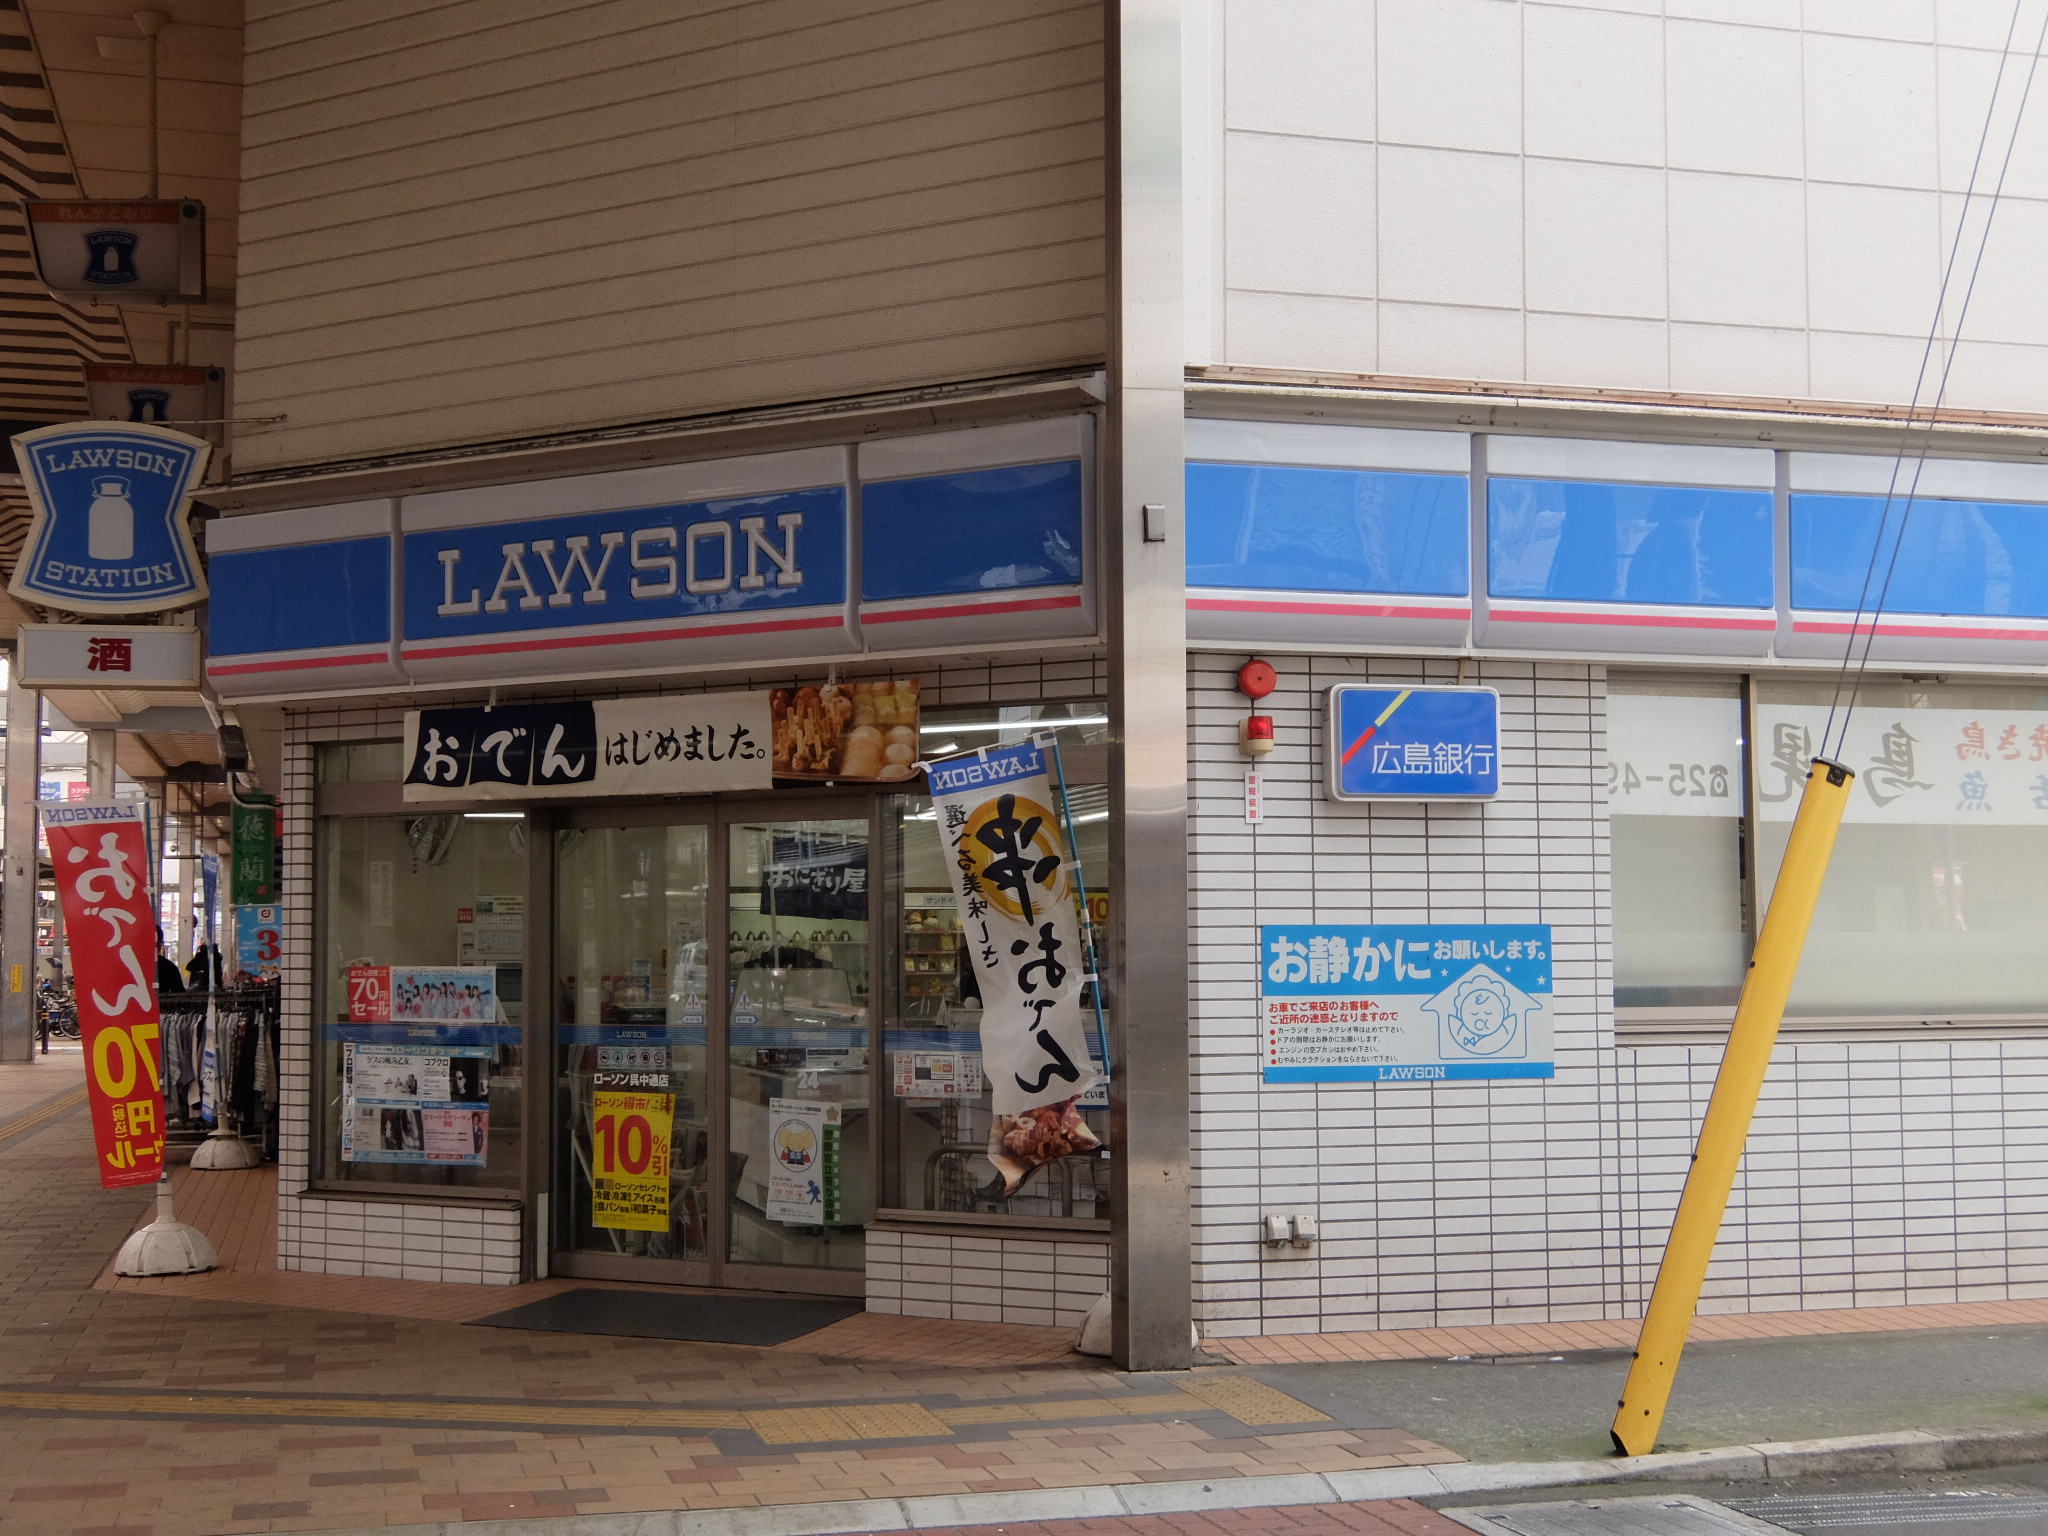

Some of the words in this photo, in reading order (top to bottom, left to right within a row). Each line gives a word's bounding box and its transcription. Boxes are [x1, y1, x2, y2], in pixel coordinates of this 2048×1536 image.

[46, 448, 176, 477] LAWSON
[45, 560, 176, 588] STATION
[437, 511, 803, 619] LAWSON
[87, 636, 133, 673] 酒
[424, 723, 584, 781] おでん
[605, 721, 766, 768] はじめました。
[1371, 741, 1495, 775] 広島銀行
[767, 863, 866, 895] おにぎり屋
[257, 929, 281, 961] 3
[1268, 935, 1432, 984] お静かに
[1433, 939, 1546, 961] お願いします。
[352, 1001, 389, 1017] セール
[1269, 1000, 1380, 1013] お車でご来店のお客様へ
[1269, 1013, 1399, 1025] ご近所の迷惑となりますので
[616, 1031, 647, 1039] LAWSON
[593, 1073, 669, 1087] ローソン呉中通店
[797, 1071, 819, 1089] 24
[1378, 1066, 1446, 1080] LAWSON
[595, 1114, 652, 1175] 10
[652, 1134, 668, 1154] %
[652, 1154, 668, 1177] 引
